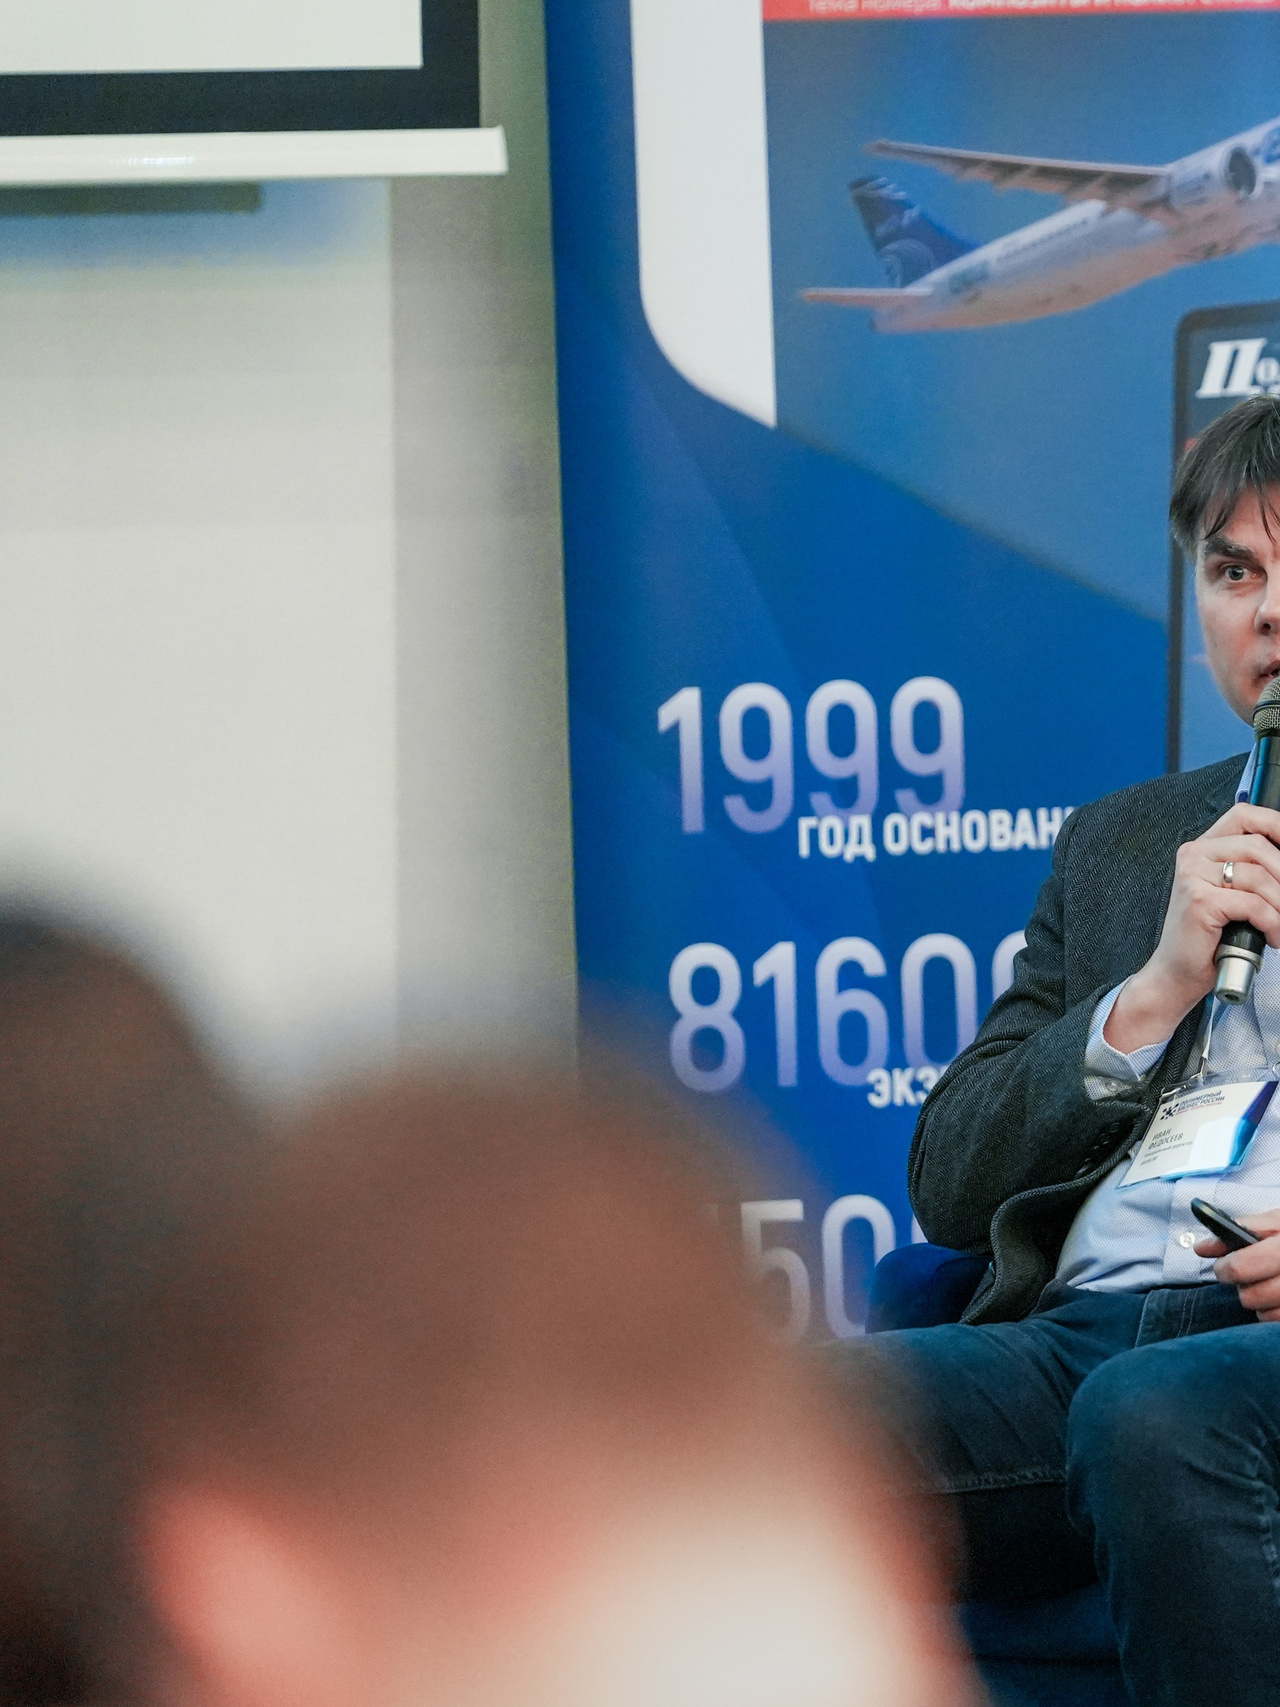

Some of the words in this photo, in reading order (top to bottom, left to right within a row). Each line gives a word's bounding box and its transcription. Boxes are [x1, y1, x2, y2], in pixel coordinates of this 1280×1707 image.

[657, 676, 966, 835] 1999
[798, 814, 876, 863] ГОД
[883, 806, 1077, 856] ОСНОВАН
[867, 1065, 949, 1109] ЭКЗ
